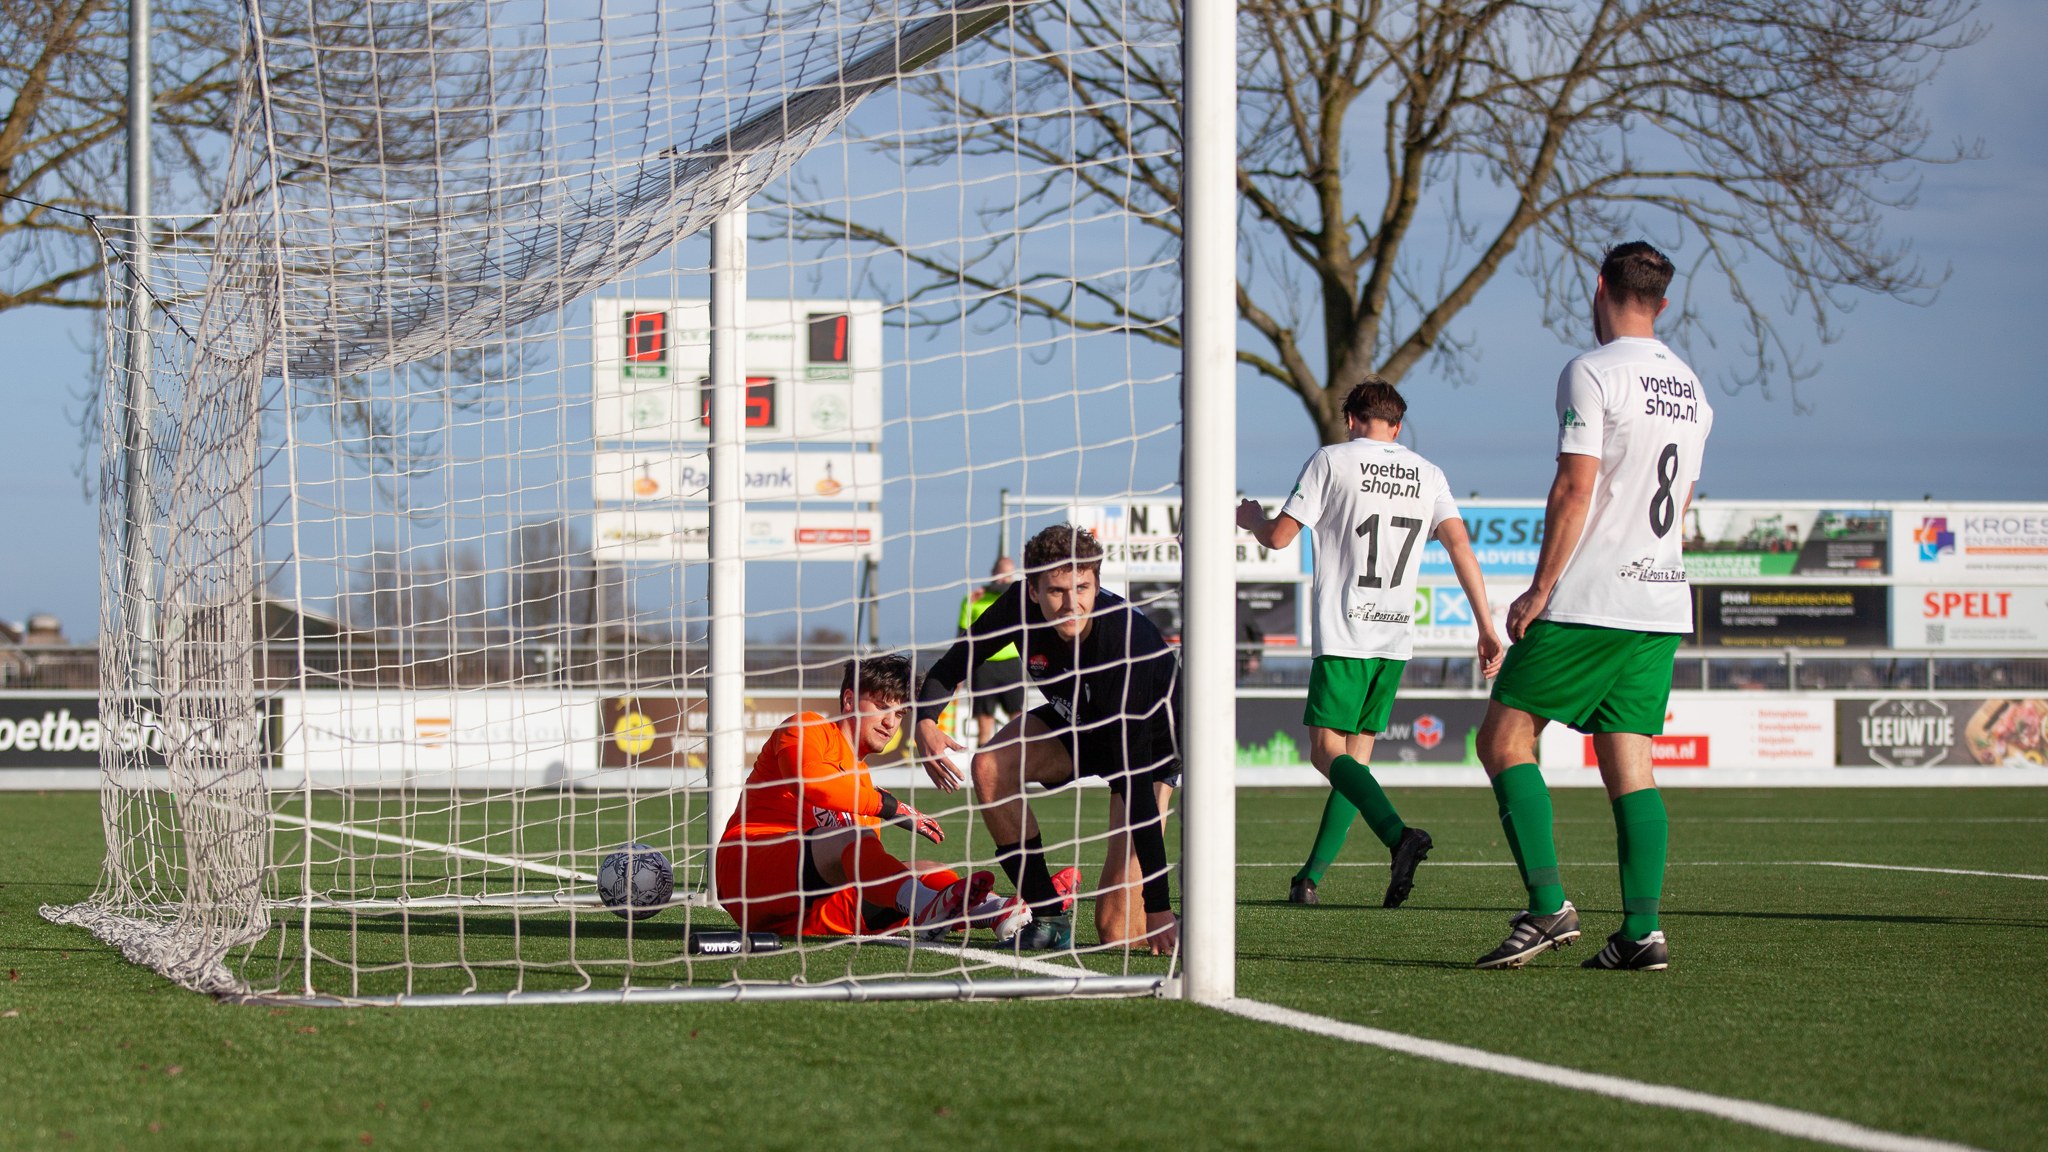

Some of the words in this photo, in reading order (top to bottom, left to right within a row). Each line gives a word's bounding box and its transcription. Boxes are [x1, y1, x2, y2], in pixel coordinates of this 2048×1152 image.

[628, 313, 664, 361] 0
[833, 315, 847, 361] 1
[1640, 376, 1697, 401] voetbal
[1645, 394, 1698, 424] shop.nl
[1360, 462, 1420, 482] voetbal
[1360, 477, 1421, 499] shop.nl
[1649, 443, 1678, 539] 8
[1355, 513, 1423, 589] 17
[1922, 591, 2013, 619] SPELT
[1860, 716, 1955, 747] LEEUWTJE
